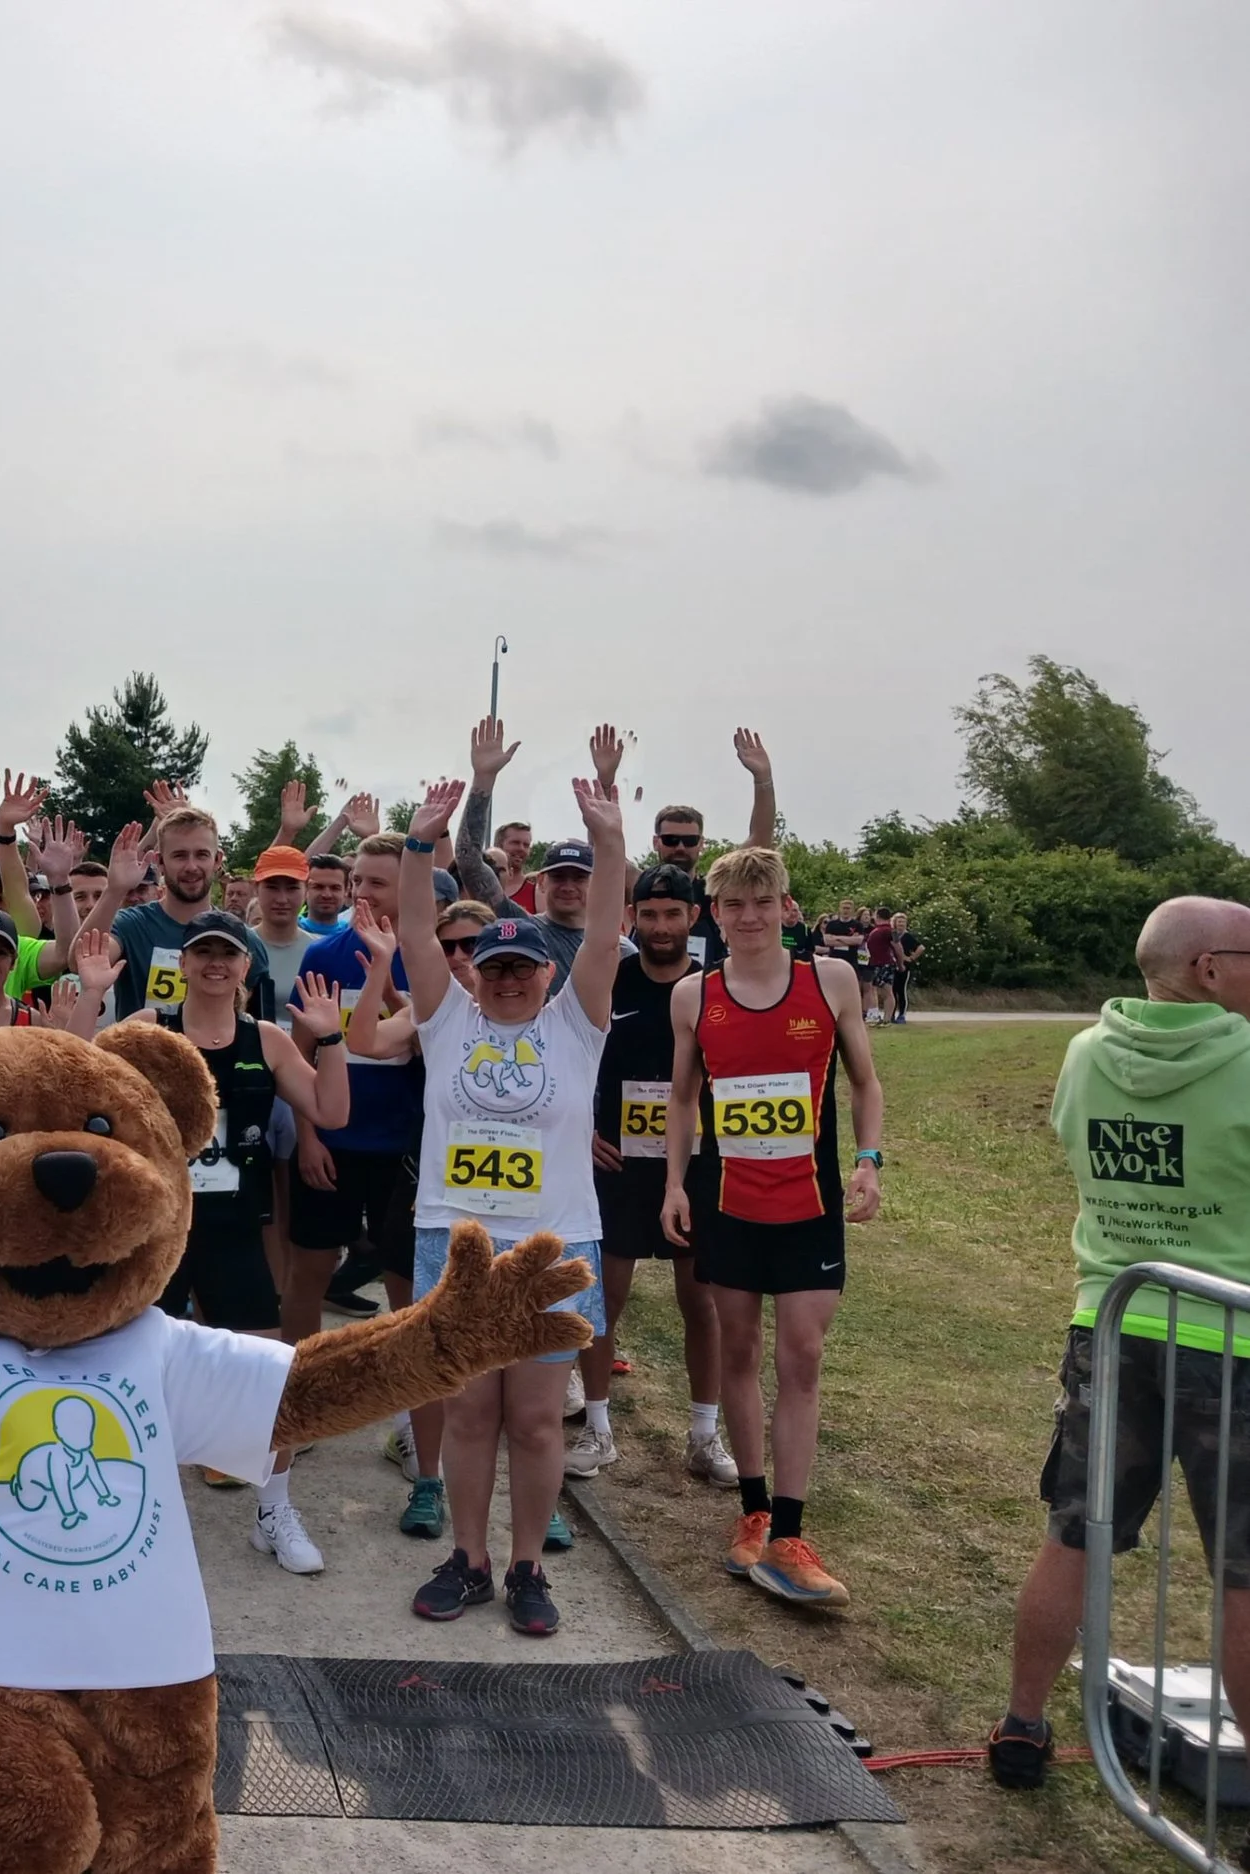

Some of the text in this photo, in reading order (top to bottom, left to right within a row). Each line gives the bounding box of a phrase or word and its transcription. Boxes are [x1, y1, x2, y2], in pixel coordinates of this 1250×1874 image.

[498, 921, 517, 940] B
[722, 1099, 806, 1136] 539
[1097, 1112, 1172, 1152] Nice
[451, 1149, 534, 1189] 543
[1090, 1147, 1182, 1182] Work
[23, 1572, 81, 1593] CARE
[93, 1560, 137, 1592] BABY
[138, 1499, 163, 1559] TRUST
